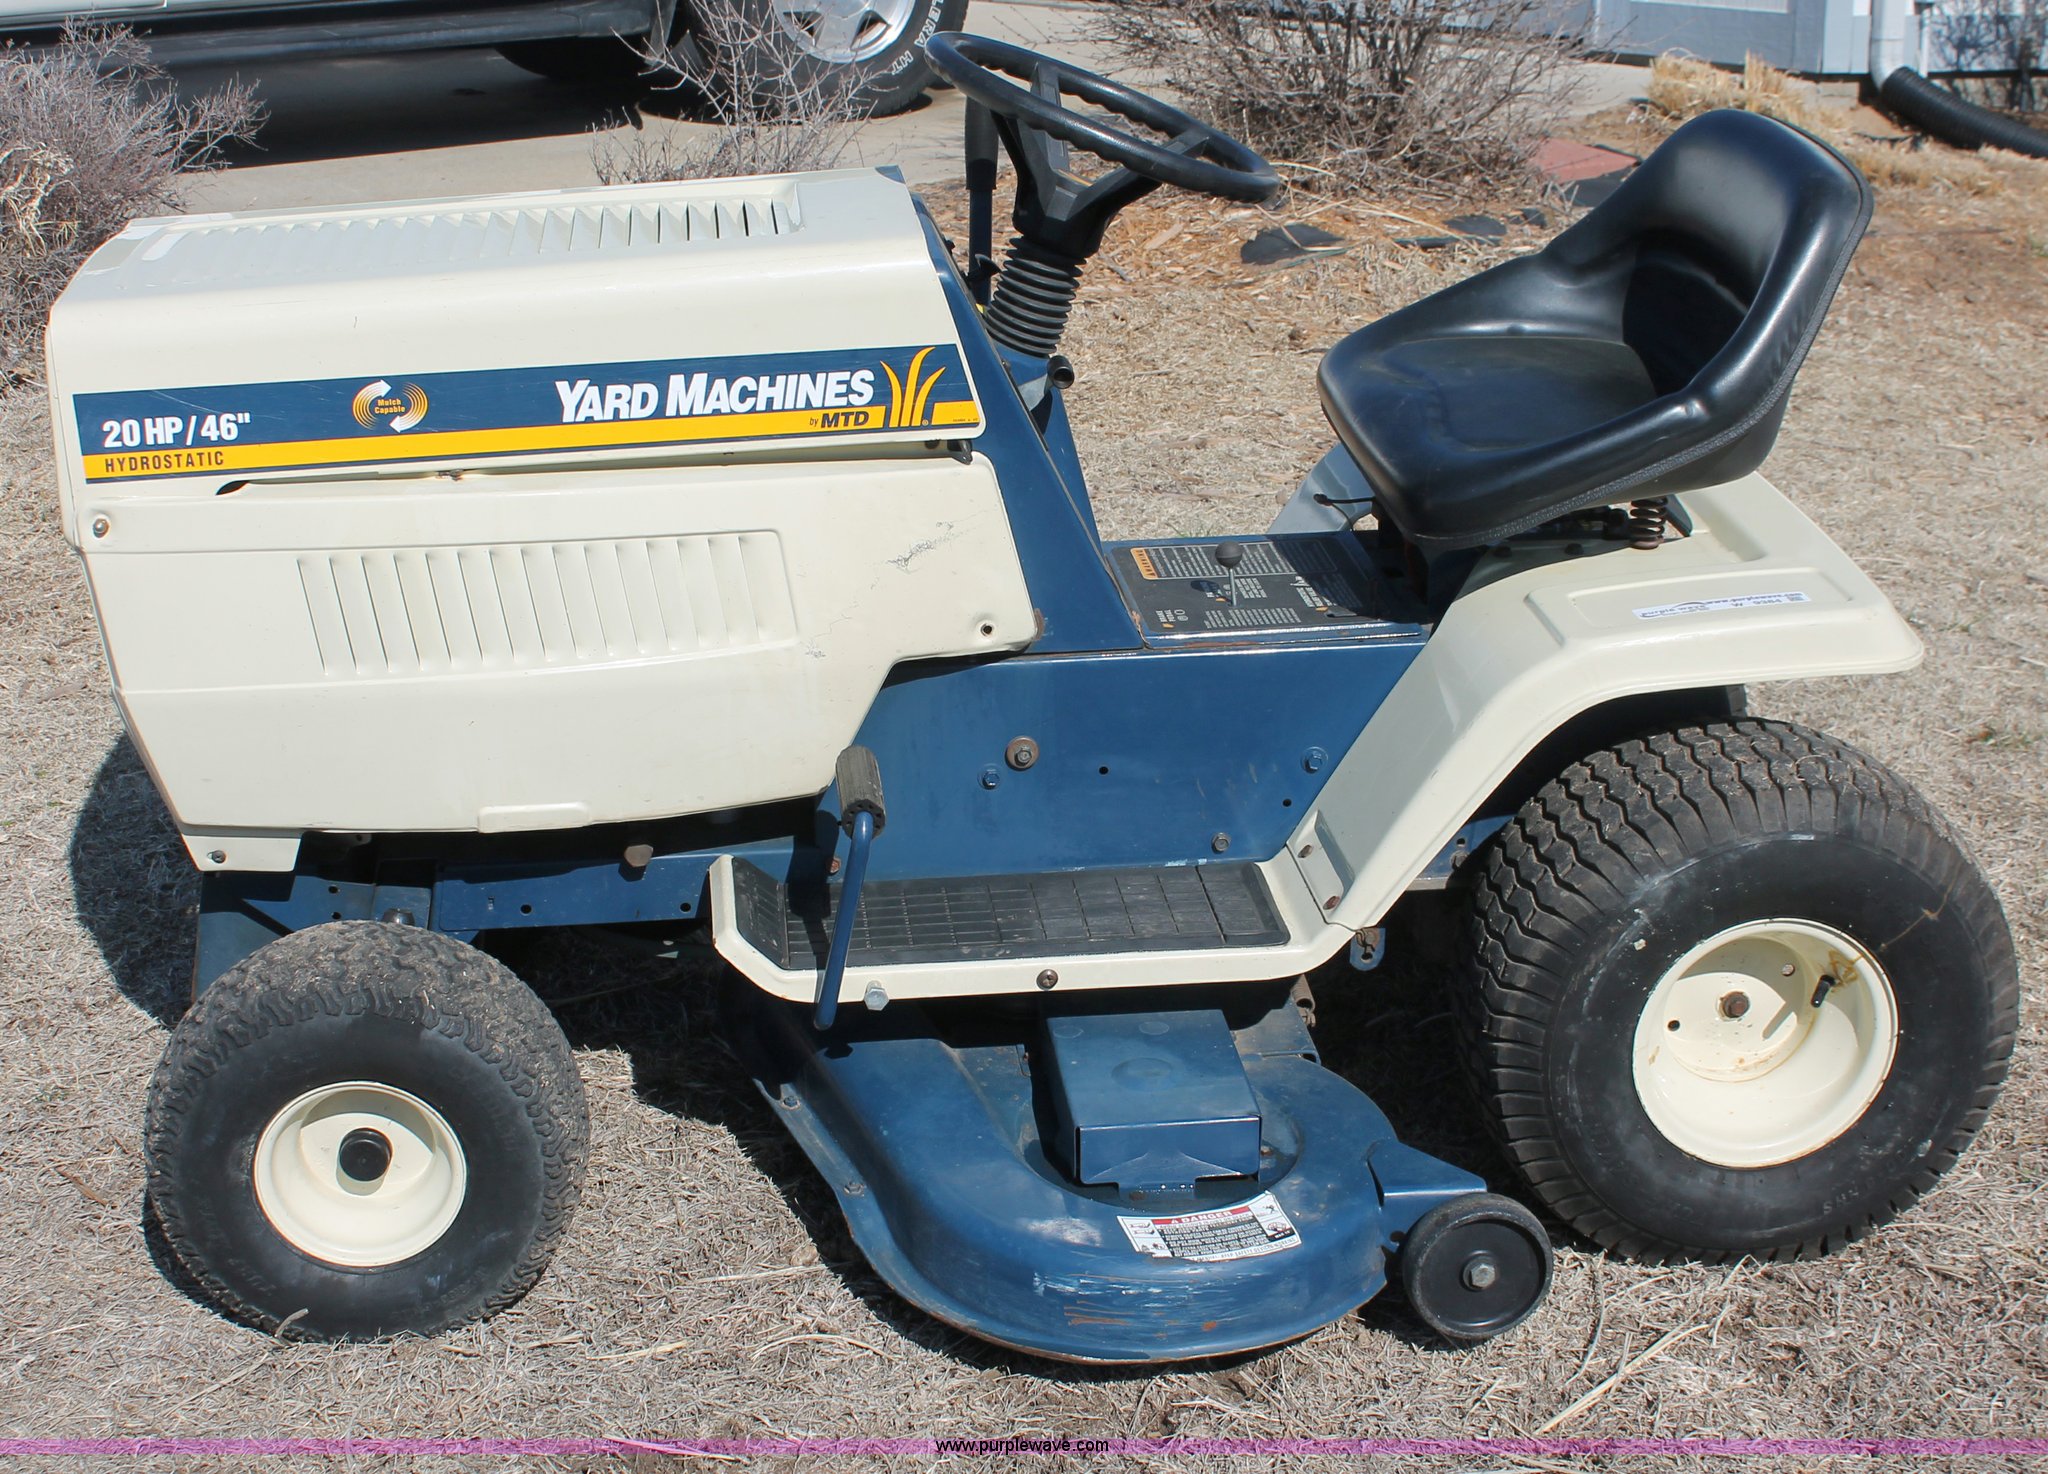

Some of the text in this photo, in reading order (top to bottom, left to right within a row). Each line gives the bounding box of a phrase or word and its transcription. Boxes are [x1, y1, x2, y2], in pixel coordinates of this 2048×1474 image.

[892, 50, 914, 75] HT
[554, 369, 875, 423] YARD MACHINES
[374, 406, 406, 415] Capable
[809, 410, 870, 428] by MTD
[104, 450, 224, 473] HYDROSTATIC
[1179, 1211, 1233, 1225] DANGER
